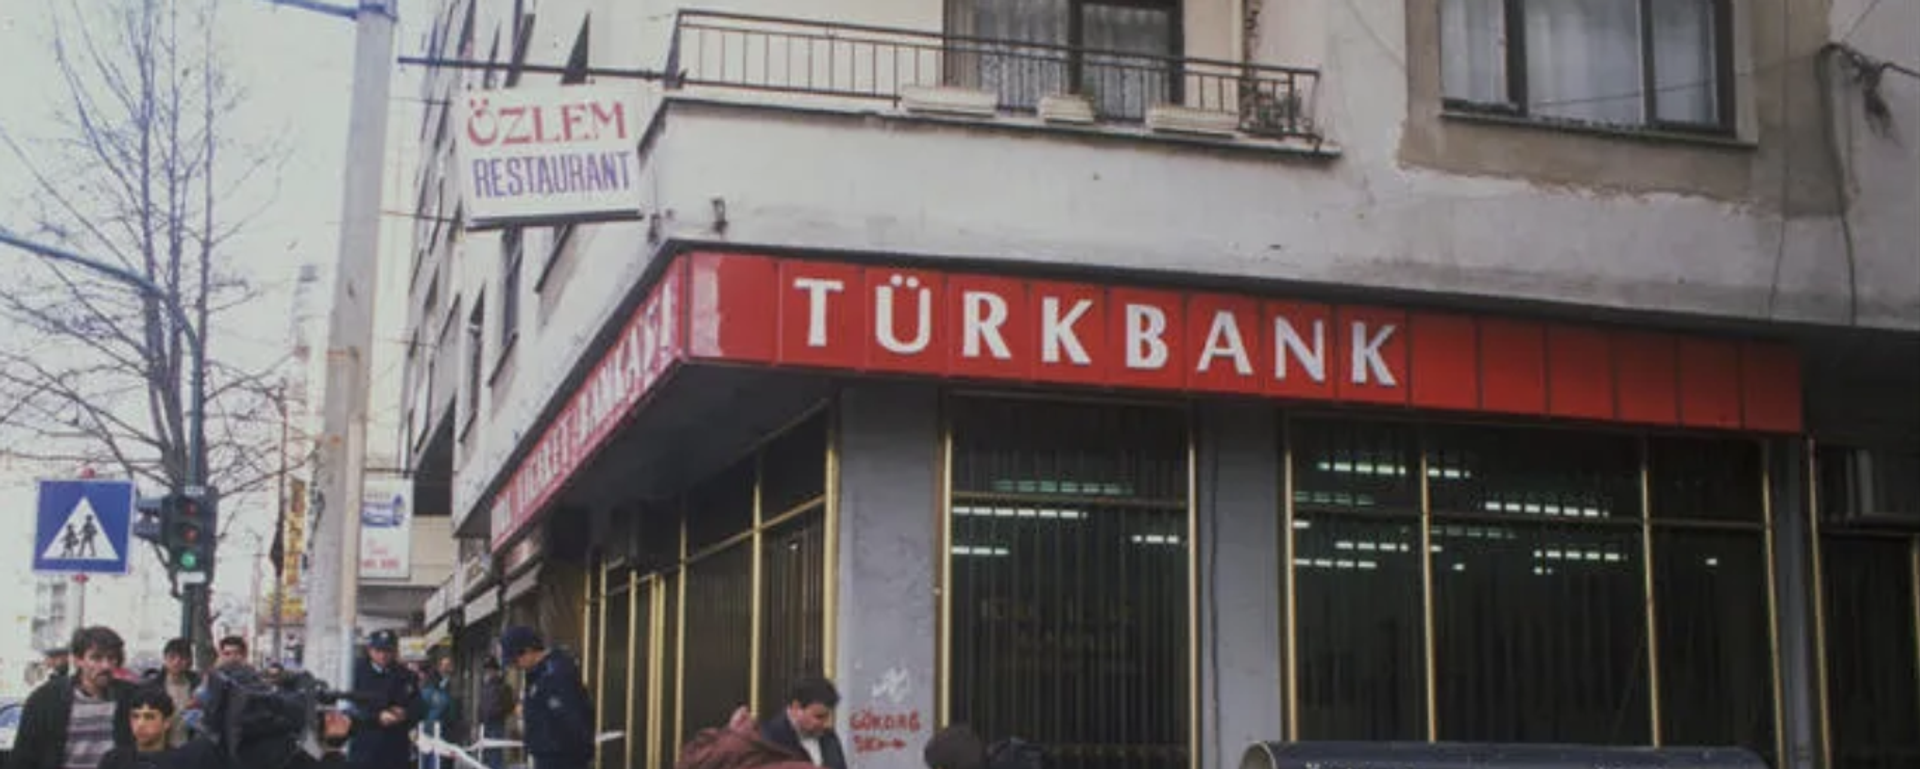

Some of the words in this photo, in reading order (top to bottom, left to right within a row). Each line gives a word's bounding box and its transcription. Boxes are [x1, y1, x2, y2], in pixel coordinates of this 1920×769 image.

[467, 98, 627, 147] ÖZLEM
[472, 151, 630, 198] RESTAURANT
[795, 274, 1396, 386] TÜRKBANK
